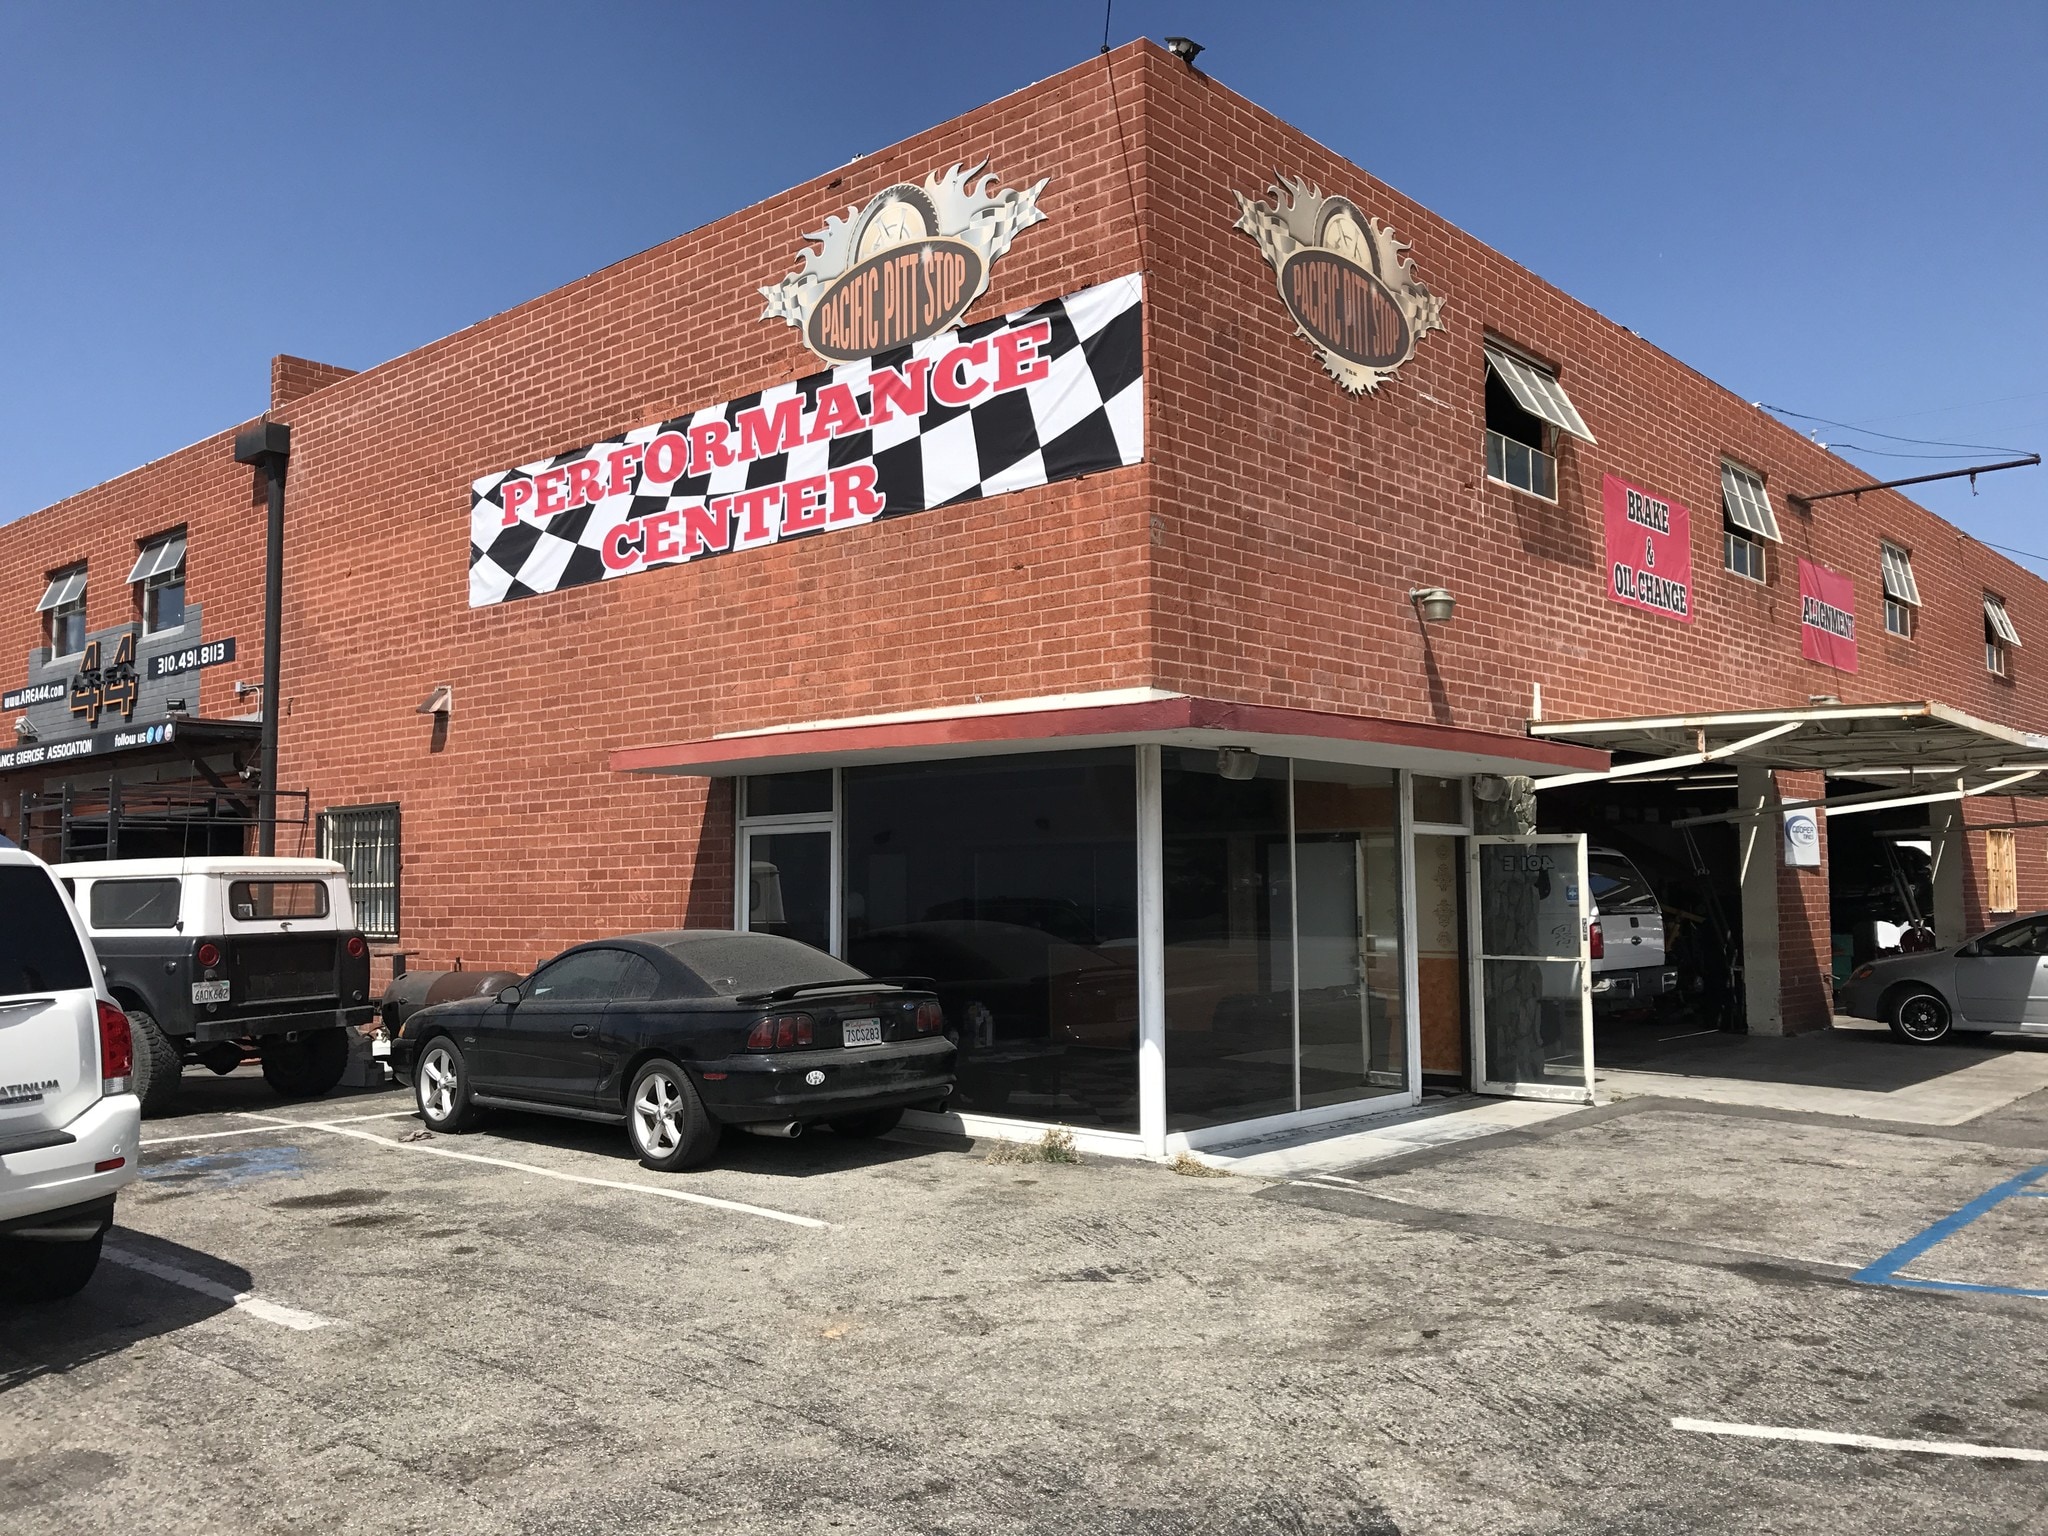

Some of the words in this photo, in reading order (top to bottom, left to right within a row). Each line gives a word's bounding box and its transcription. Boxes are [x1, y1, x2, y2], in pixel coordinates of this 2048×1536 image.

[820, 266, 879, 350] PACIFIC
[883, 252, 919, 346] PITT
[924, 251, 966, 327] STOP
[1293, 260, 1341, 345] PACIFIC
[1343, 267, 1370, 356] PITT
[1373, 291, 1400, 357] STOP
[500, 318, 1052, 527] PERFORMANCE
[601, 462, 886, 572] CENTER
[1626, 488, 1670, 536] BRAKE
[1645, 537, 1655, 568] &
[1613, 561, 1637, 601] OIL
[1637, 571, 1688, 617] CHANGE
[1801, 595, 1855, 642] ALIGNMENT
[70, 662, 137, 691] AREA
[157, 644, 225, 675] 310.491.8113
[16, 747, 45, 765] EXERCISE
[47, 739, 93, 760] ASSOCIATION
[114, 733, 136, 747] follow
[137, 732, 146, 743] us
